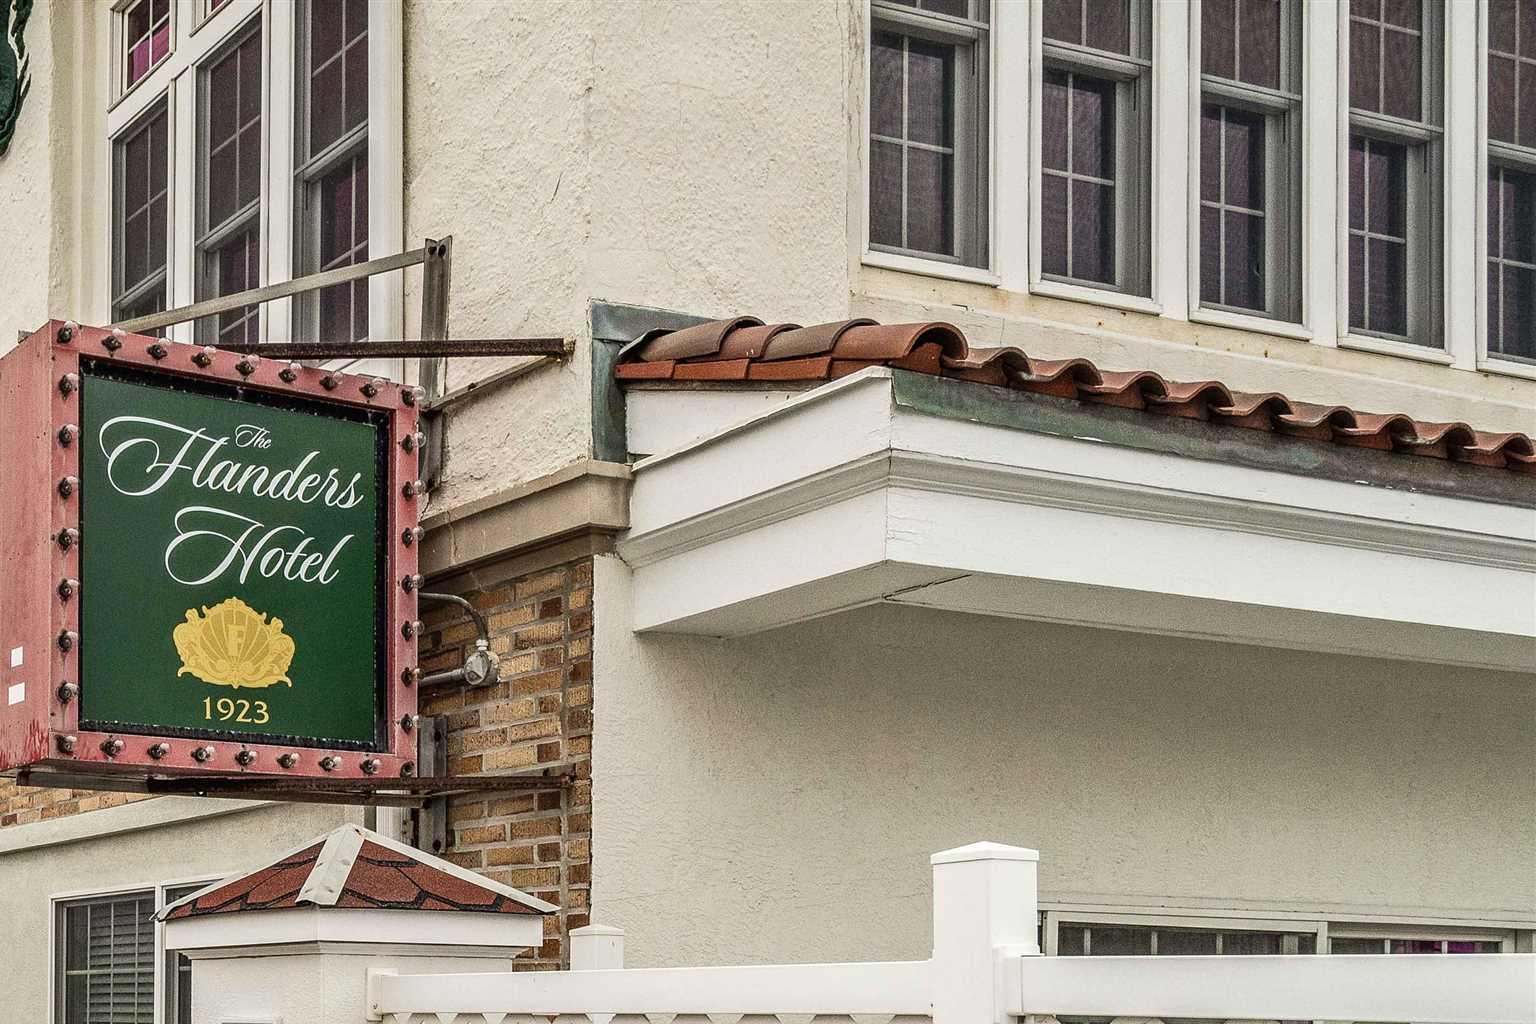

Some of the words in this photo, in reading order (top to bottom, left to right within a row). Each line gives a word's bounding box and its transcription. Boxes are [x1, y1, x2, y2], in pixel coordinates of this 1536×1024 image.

[99, 416, 364, 509] Flanders
[234, 424, 272, 449] The
[165, 506, 355, 585] Hotel
[203, 696, 270, 724] 1923
